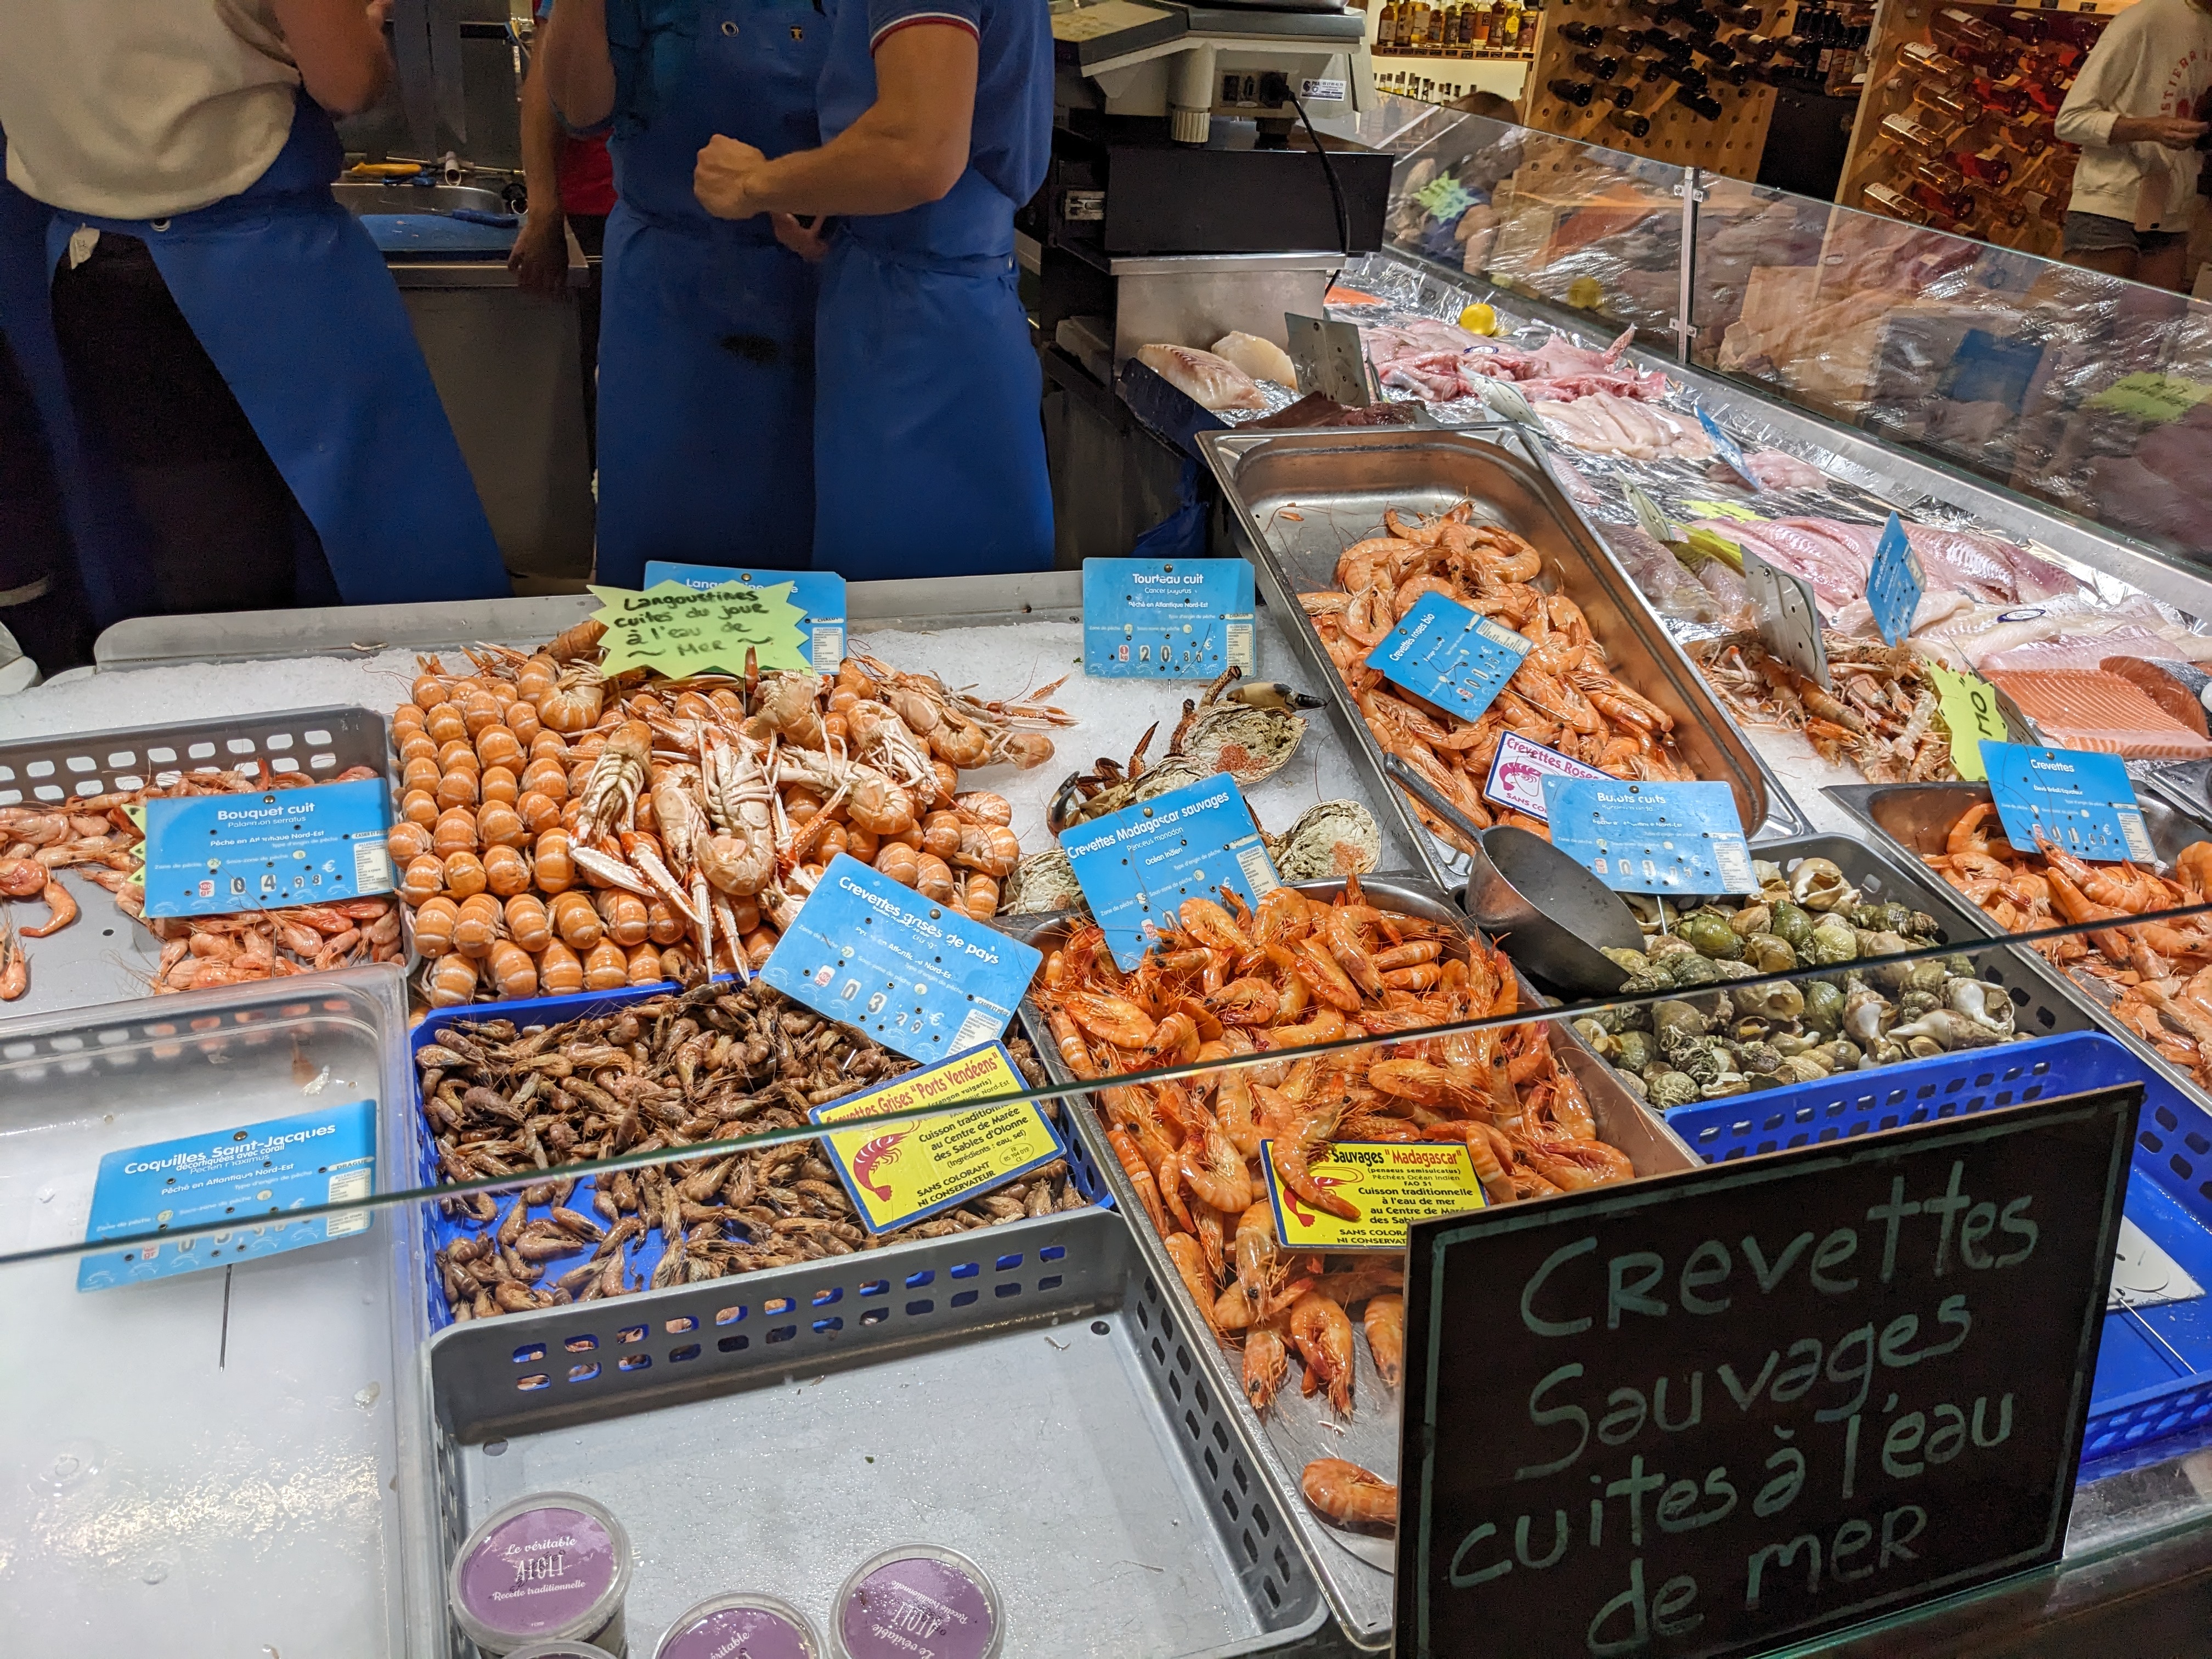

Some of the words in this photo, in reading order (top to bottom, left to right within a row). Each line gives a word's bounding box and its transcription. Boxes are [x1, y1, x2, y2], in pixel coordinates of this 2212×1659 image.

[1132, 573, 1180, 584] Tourteau
[1183, 573, 1204, 584] cuit
[614, 611, 674, 628] cuites
[686, 607, 710, 618] du
[720, 622, 752, 632] de
[1389, 637, 1415, 661] Crevettes
[1411, 623, 1427, 639] roses
[1420, 613, 1435, 625] bio
[1507, 737, 1561, 769] Crevettes
[2030, 759, 2075, 772] Crevettes
[1506, 793, 1530, 806] SANS
[218, 806, 284, 820] Bouquet
[287, 802, 315, 814] cuit
[291, 831, 324, 839] Nord-Est
[1067, 834, 1116, 860] Crevettes
[1116, 810, 1180, 841] Madagascar
[1181, 792, 1229, 818] sauvages
[1154, 827, 1183, 842] monodon
[1145, 855, 1165, 866] Océan
[1165, 848, 1183, 859] Indien
[1207, 848, 1221, 859] pêche
[234, 878, 245, 893] 0
[264, 875, 276, 890] 4
[295, 877, 302, 887] 9
[312, 874, 320, 884] 8
[322, 860, 335, 872] €
[1178, 877, 1192, 885] pêche
[1119, 899, 1133, 910] pêche
[839, 876, 900, 917] Crevettes
[965, 943, 998, 964] pays
[842, 983, 857, 1000] 0
[867, 995, 883, 1013] 3
[896, 1013, 905, 1026] 2
[912, 1021, 922, 1032] 9
[929, 1012, 944, 1026] €
[978, 1000, 992, 1009] CASIER
[878, 1090, 913, 1114] Grises
[911, 1078, 947, 1099] "Ports
[944, 1052, 998, 1086] Vendéens"
[961, 1078, 992, 1094] vulgaris)
[981, 1080, 1010, 1096] Nord-Est
[919, 1122, 956, 1142] Cuisson
[931, 1141, 943, 1151] au
[944, 1127, 976, 1144] Centre
[977, 1121, 989, 1131] de
[992, 1107, 1020, 1125] Marée
[934, 1149, 952, 1162] des
[952, 1135, 985, 1154] Sables
[986, 1116, 1029, 1140] d'Olonne
[124, 1151, 206, 1175] Coquilles
[211, 1124, 336, 1158] Saint-Jacques
[176, 1154, 234, 1172] décortiquées
[236, 1150, 258, 1160] avec
[260, 1143, 285, 1155] corail
[947, 1146, 991, 1169] (Ingrédients
[996, 1137, 1012, 1148] eau,
[1013, 1129, 1026, 1140] sel)
[1332, 1150, 1384, 1167] Sauvages
[1385, 1149, 1462, 1168] "Madagascar"
[256, 1163, 295, 1177] Nord-Est
[917, 1182, 942, 1197] SANS
[943, 1161, 990, 1186] COLORANT
[917, 1198, 929, 1207] NI
[929, 1170, 996, 1203] CONSERVATEUR
[1358, 1187, 1399, 1195] Cuisson
[1401, 1188, 1474, 1196] traditionnelle
[1515, 1294, 1972, 1481] Sauvages
[1448, 1455, 1738, 1588] cuites
[1752, 1426, 1806, 1517] à
[1842, 1392, 2015, 1499] l'eau
[505, 1544, 522, 1555] Le
[524, 1536, 577, 1552] véritable
[492, 1589, 526, 1601] Recette
[527, 1579, 586, 1595] traditionnelle
[891, 1580, 941, 1609] traditionnelle
[1587, 1558, 1705, 1656] de
[872, 1624, 918, 1650] véritable
